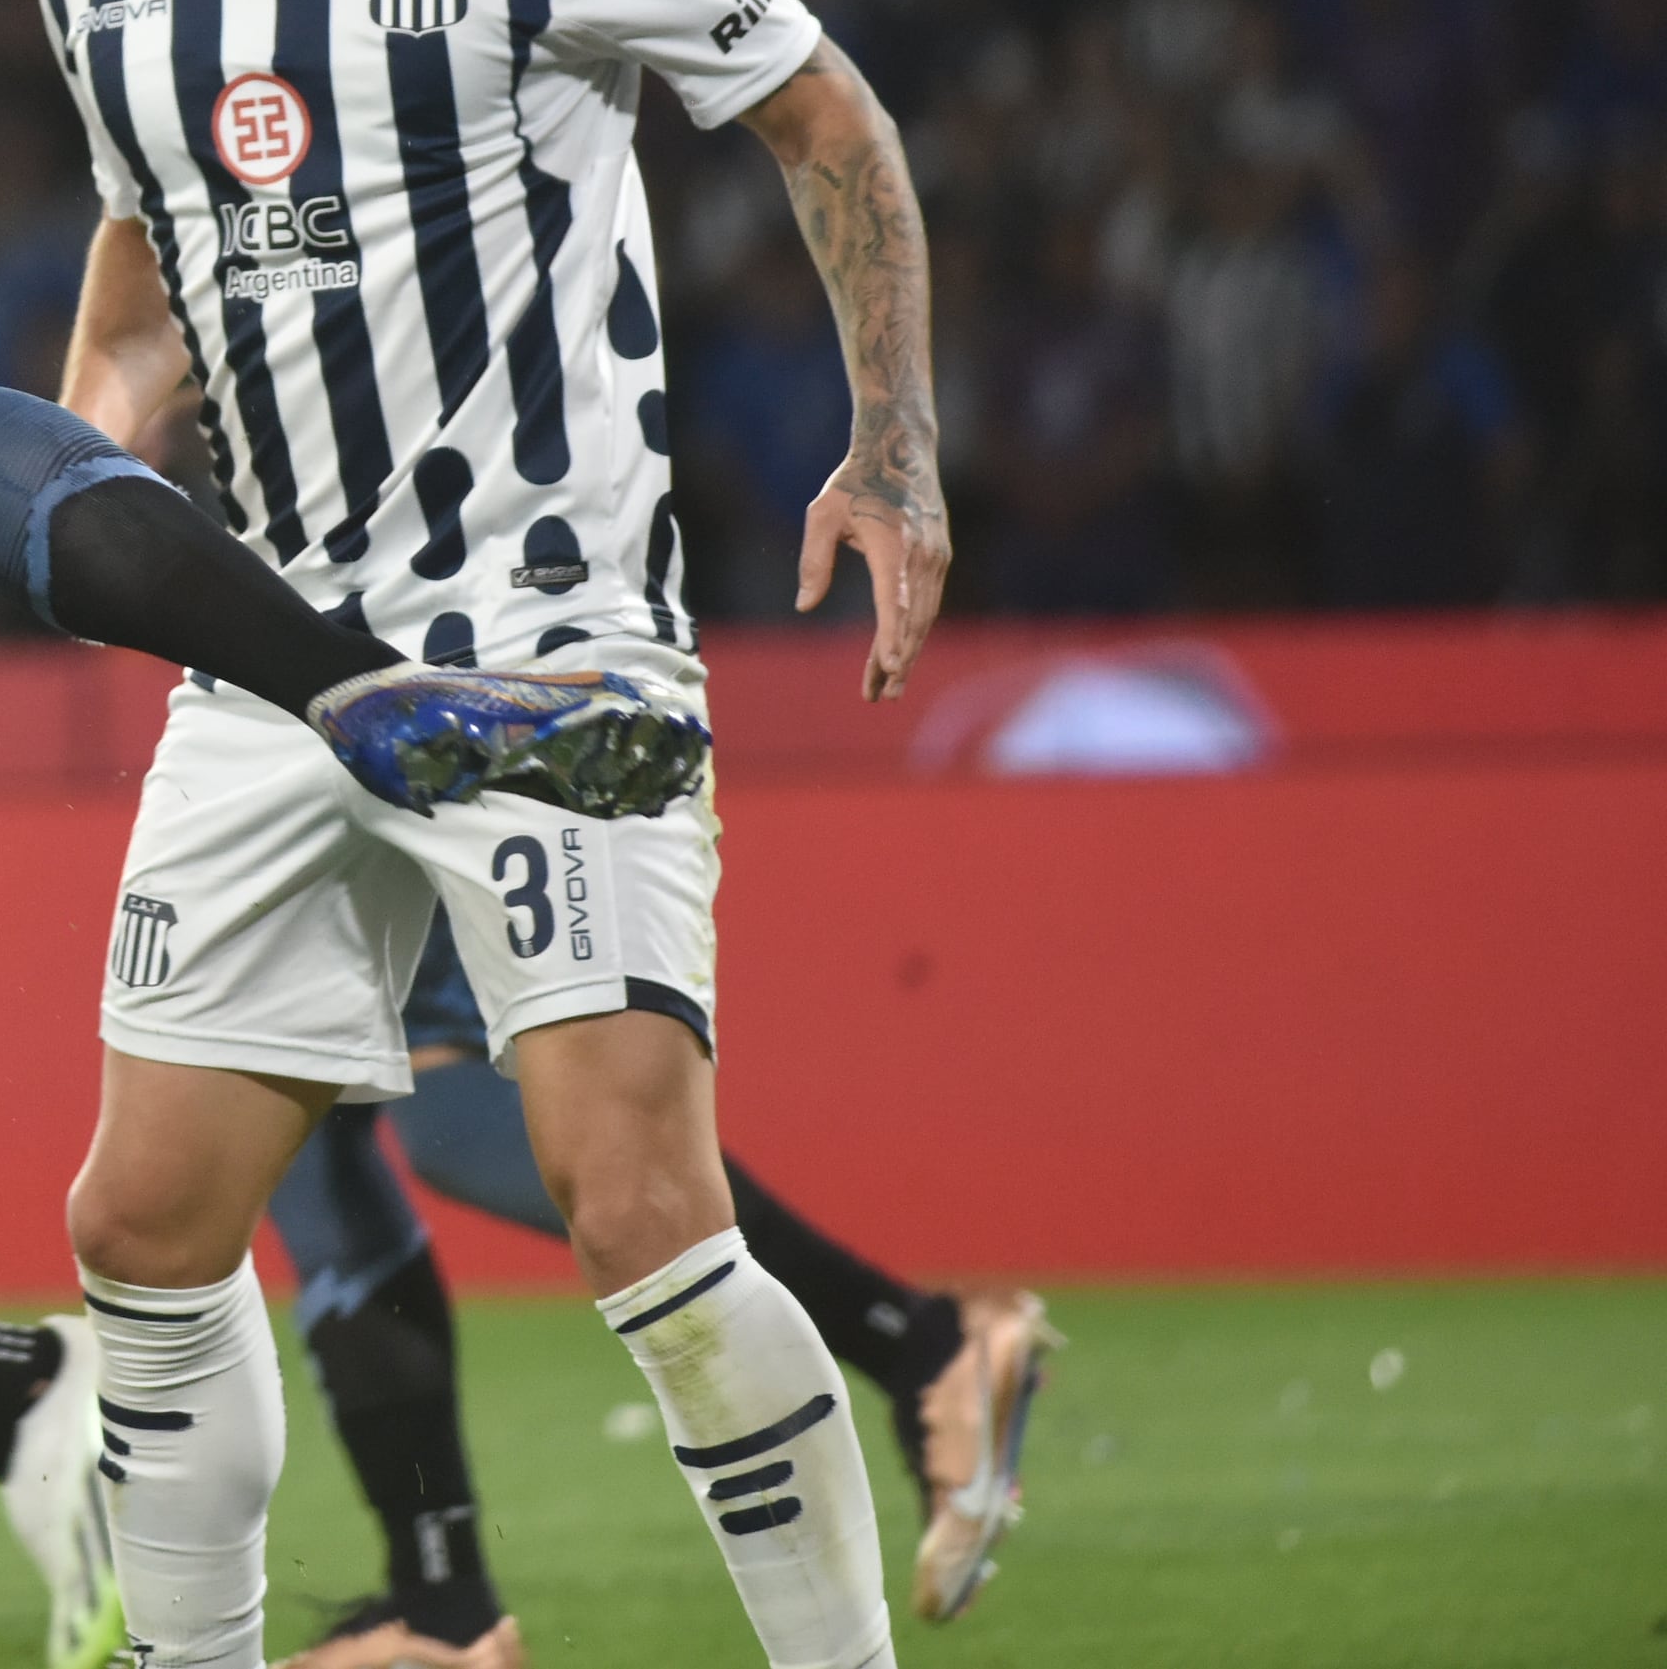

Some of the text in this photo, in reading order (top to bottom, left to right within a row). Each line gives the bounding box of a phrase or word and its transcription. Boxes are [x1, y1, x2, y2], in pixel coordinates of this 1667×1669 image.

[219, 196, 349, 257] ICBC
[224, 258, 358, 303] Argentina
[491, 834, 555, 959] 3
[561, 828, 593, 961] GIVOVA
